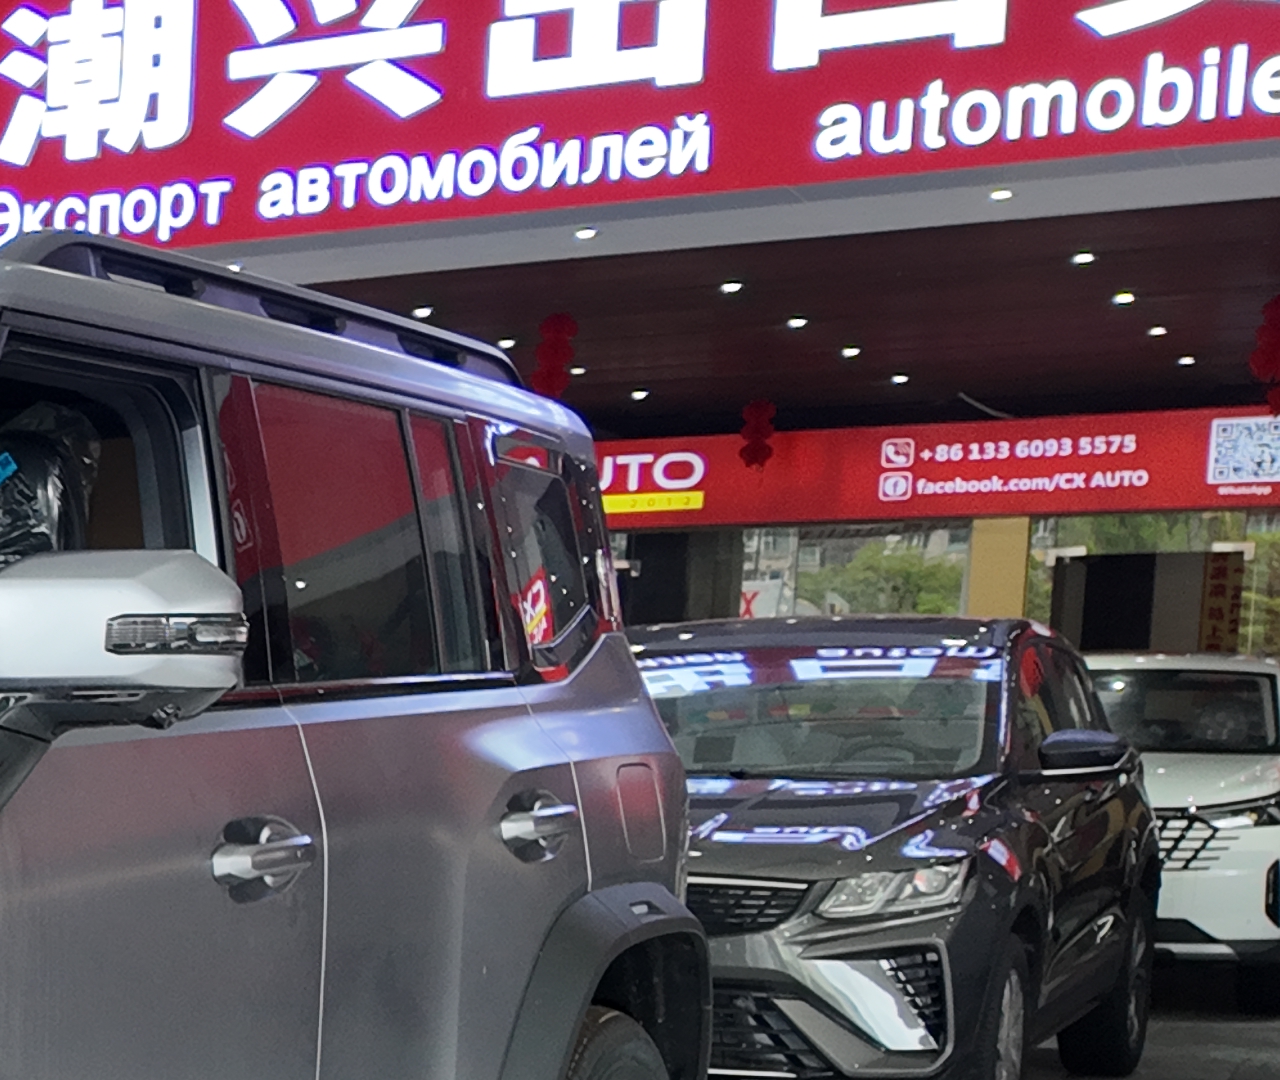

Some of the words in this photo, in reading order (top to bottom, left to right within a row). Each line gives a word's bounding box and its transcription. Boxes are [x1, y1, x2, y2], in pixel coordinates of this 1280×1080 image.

[258, 112, 713, 220] автомобилей
[919, 444, 963, 464] +86
[968, 441, 1011, 461] 133
[1015, 437, 1074, 459] 6093
[1078, 434, 1137, 456] 5575
[915, 470, 1087, 495] facebook.com/CX
[1091, 469, 1150, 489] AUTO
